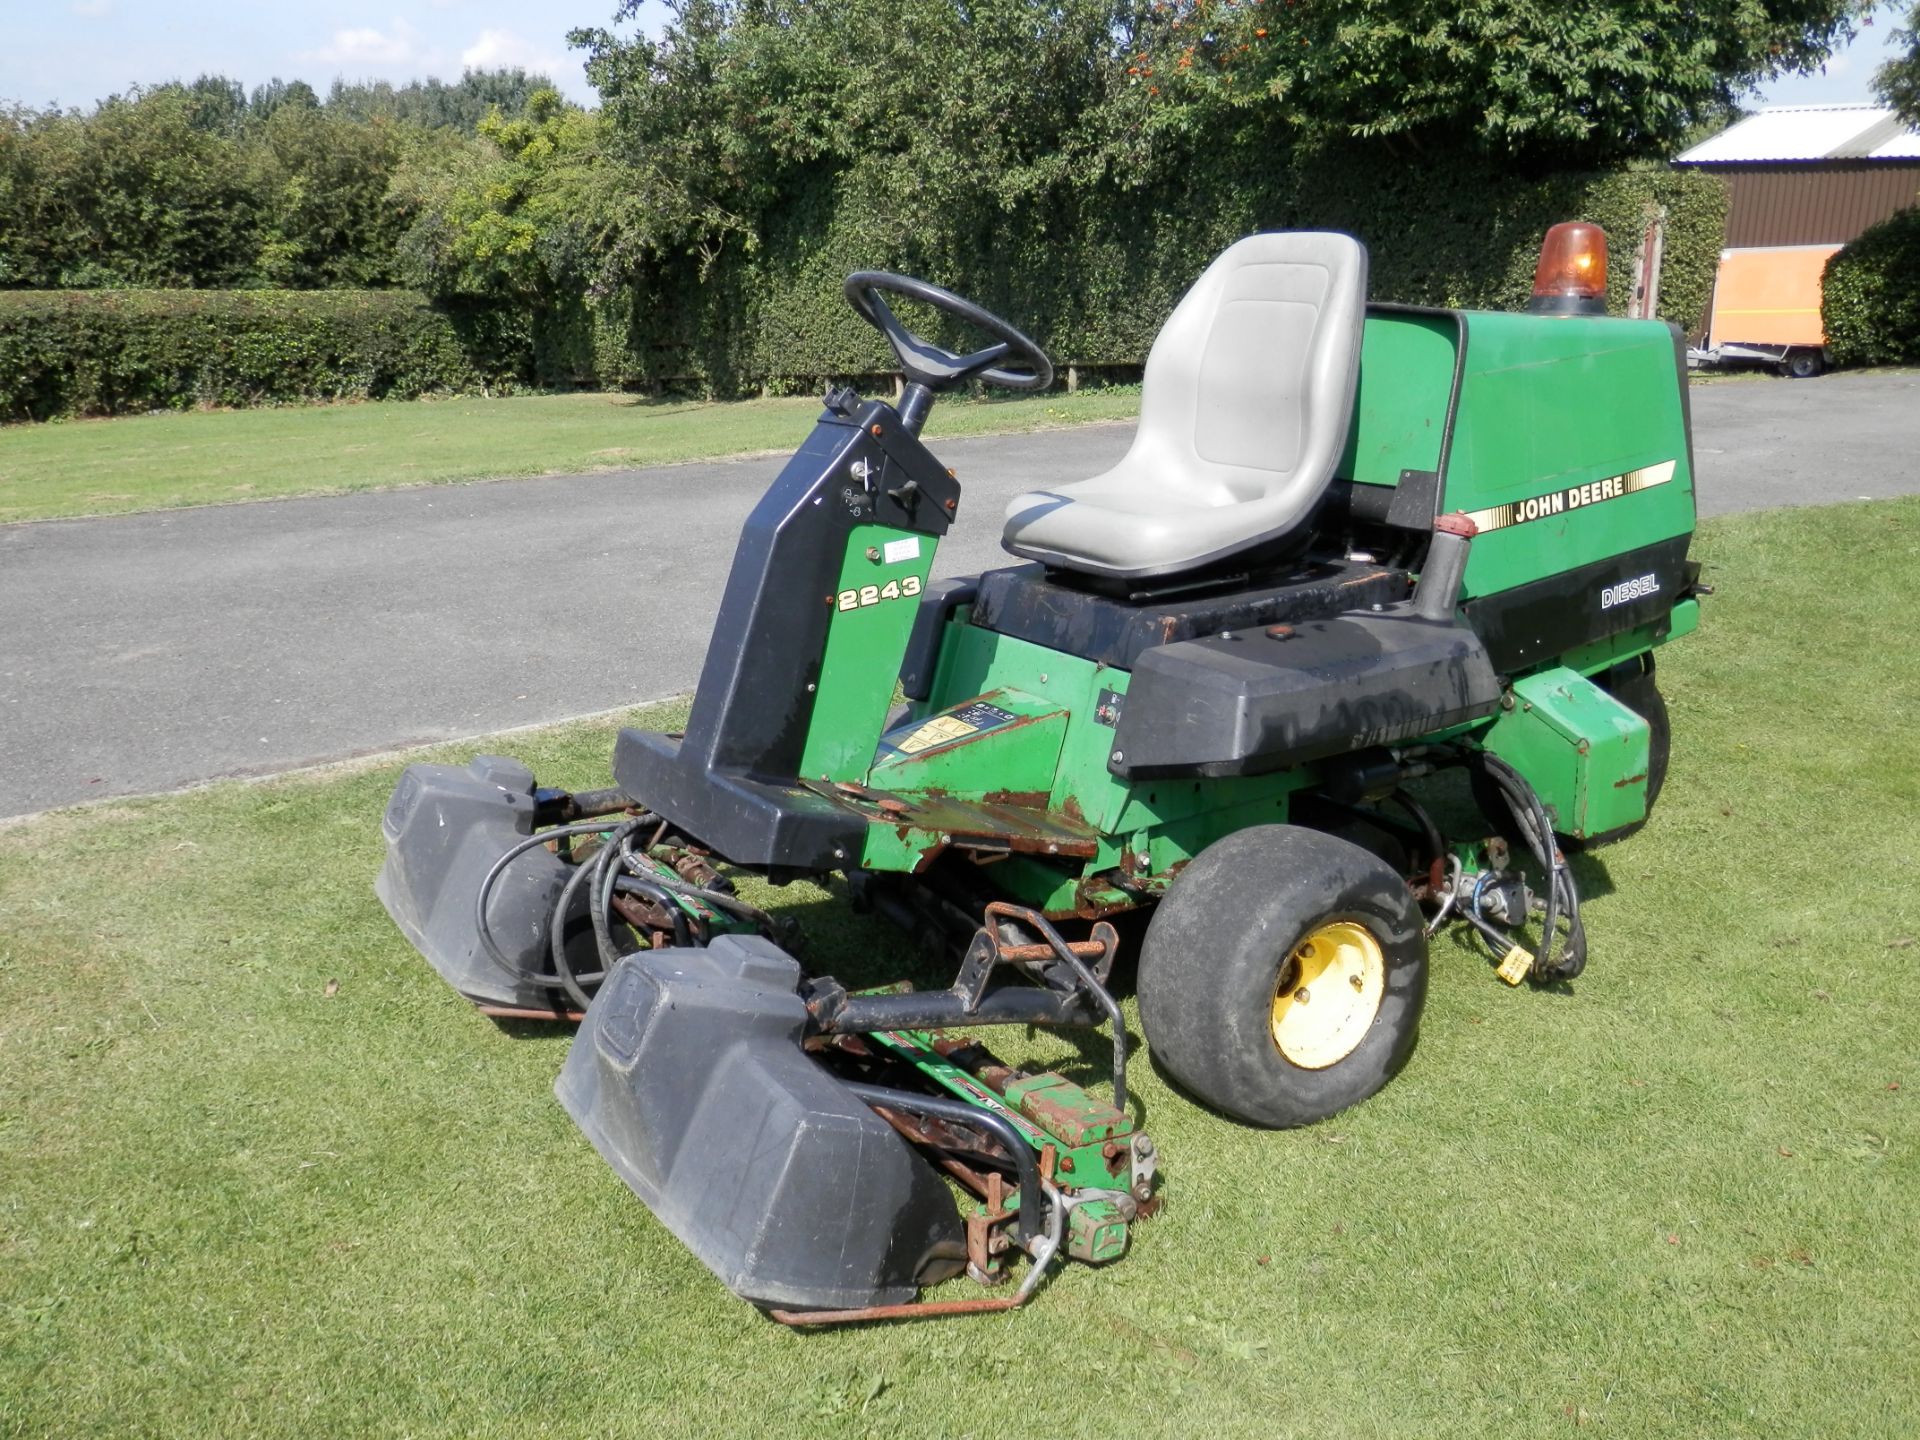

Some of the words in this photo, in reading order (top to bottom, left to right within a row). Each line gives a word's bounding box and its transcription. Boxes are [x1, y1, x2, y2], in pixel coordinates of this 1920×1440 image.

[1515, 492, 1563, 522] JOHN
[1568, 476, 1623, 509] DEERE
[838, 575, 921, 612] 2243
[1601, 573, 1660, 609] DIESEL
